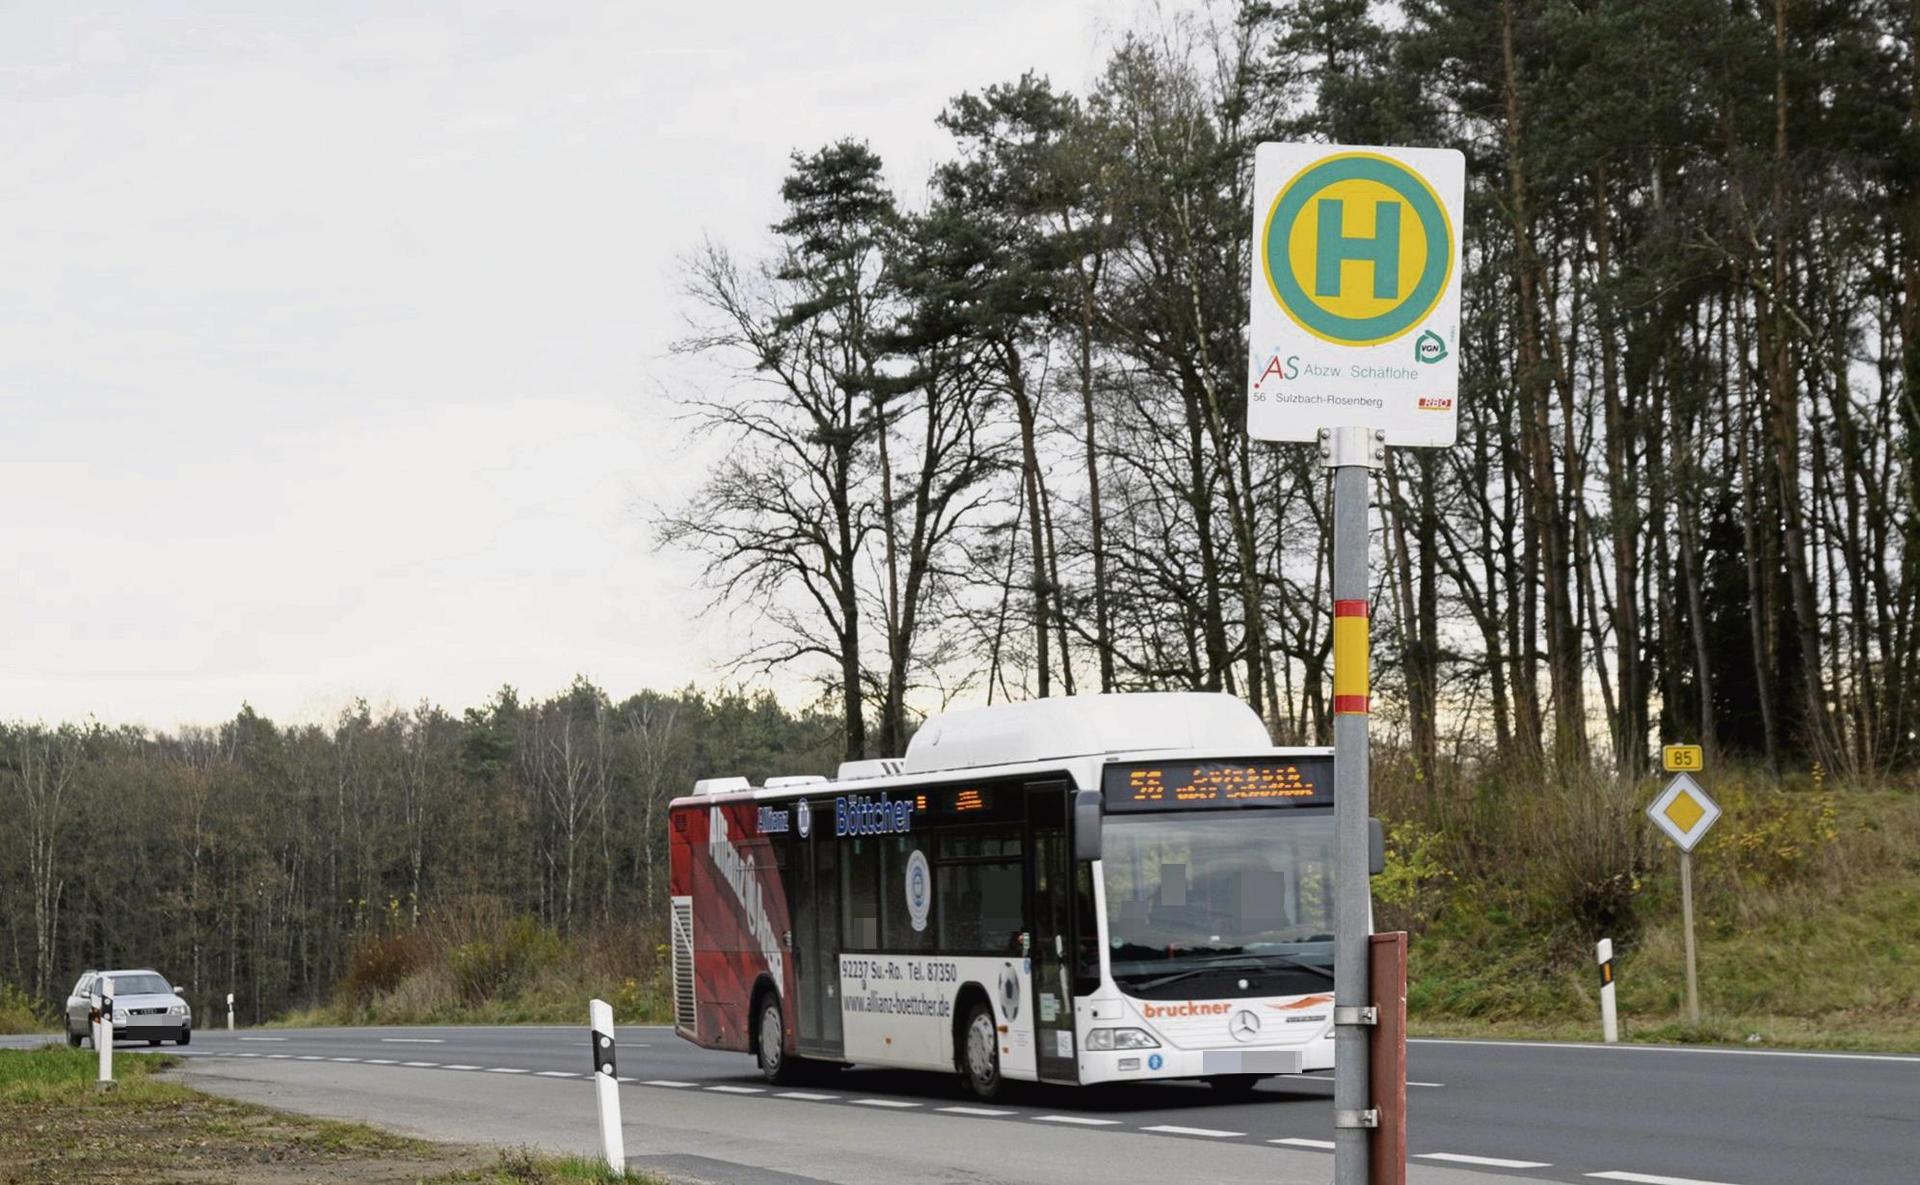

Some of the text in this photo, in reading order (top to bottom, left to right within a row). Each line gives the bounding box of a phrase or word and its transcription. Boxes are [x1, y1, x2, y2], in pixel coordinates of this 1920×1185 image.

[1315, 198, 1401, 299] H
[1421, 344, 1439, 352] VGN
[1253, 392, 1384, 409] 56 Sulzbach-Rosenberg
[1674, 751, 1692, 766] 85
[835, 791, 914, 837] Böttcher
[841, 960, 869, 979] 92237
[907, 961, 926, 981] Tel.
[927, 962, 958, 982] 87350
[842, 989, 951, 1018] www.allianz-boettcher.de
[1144, 1001, 1233, 1018] bruckner
